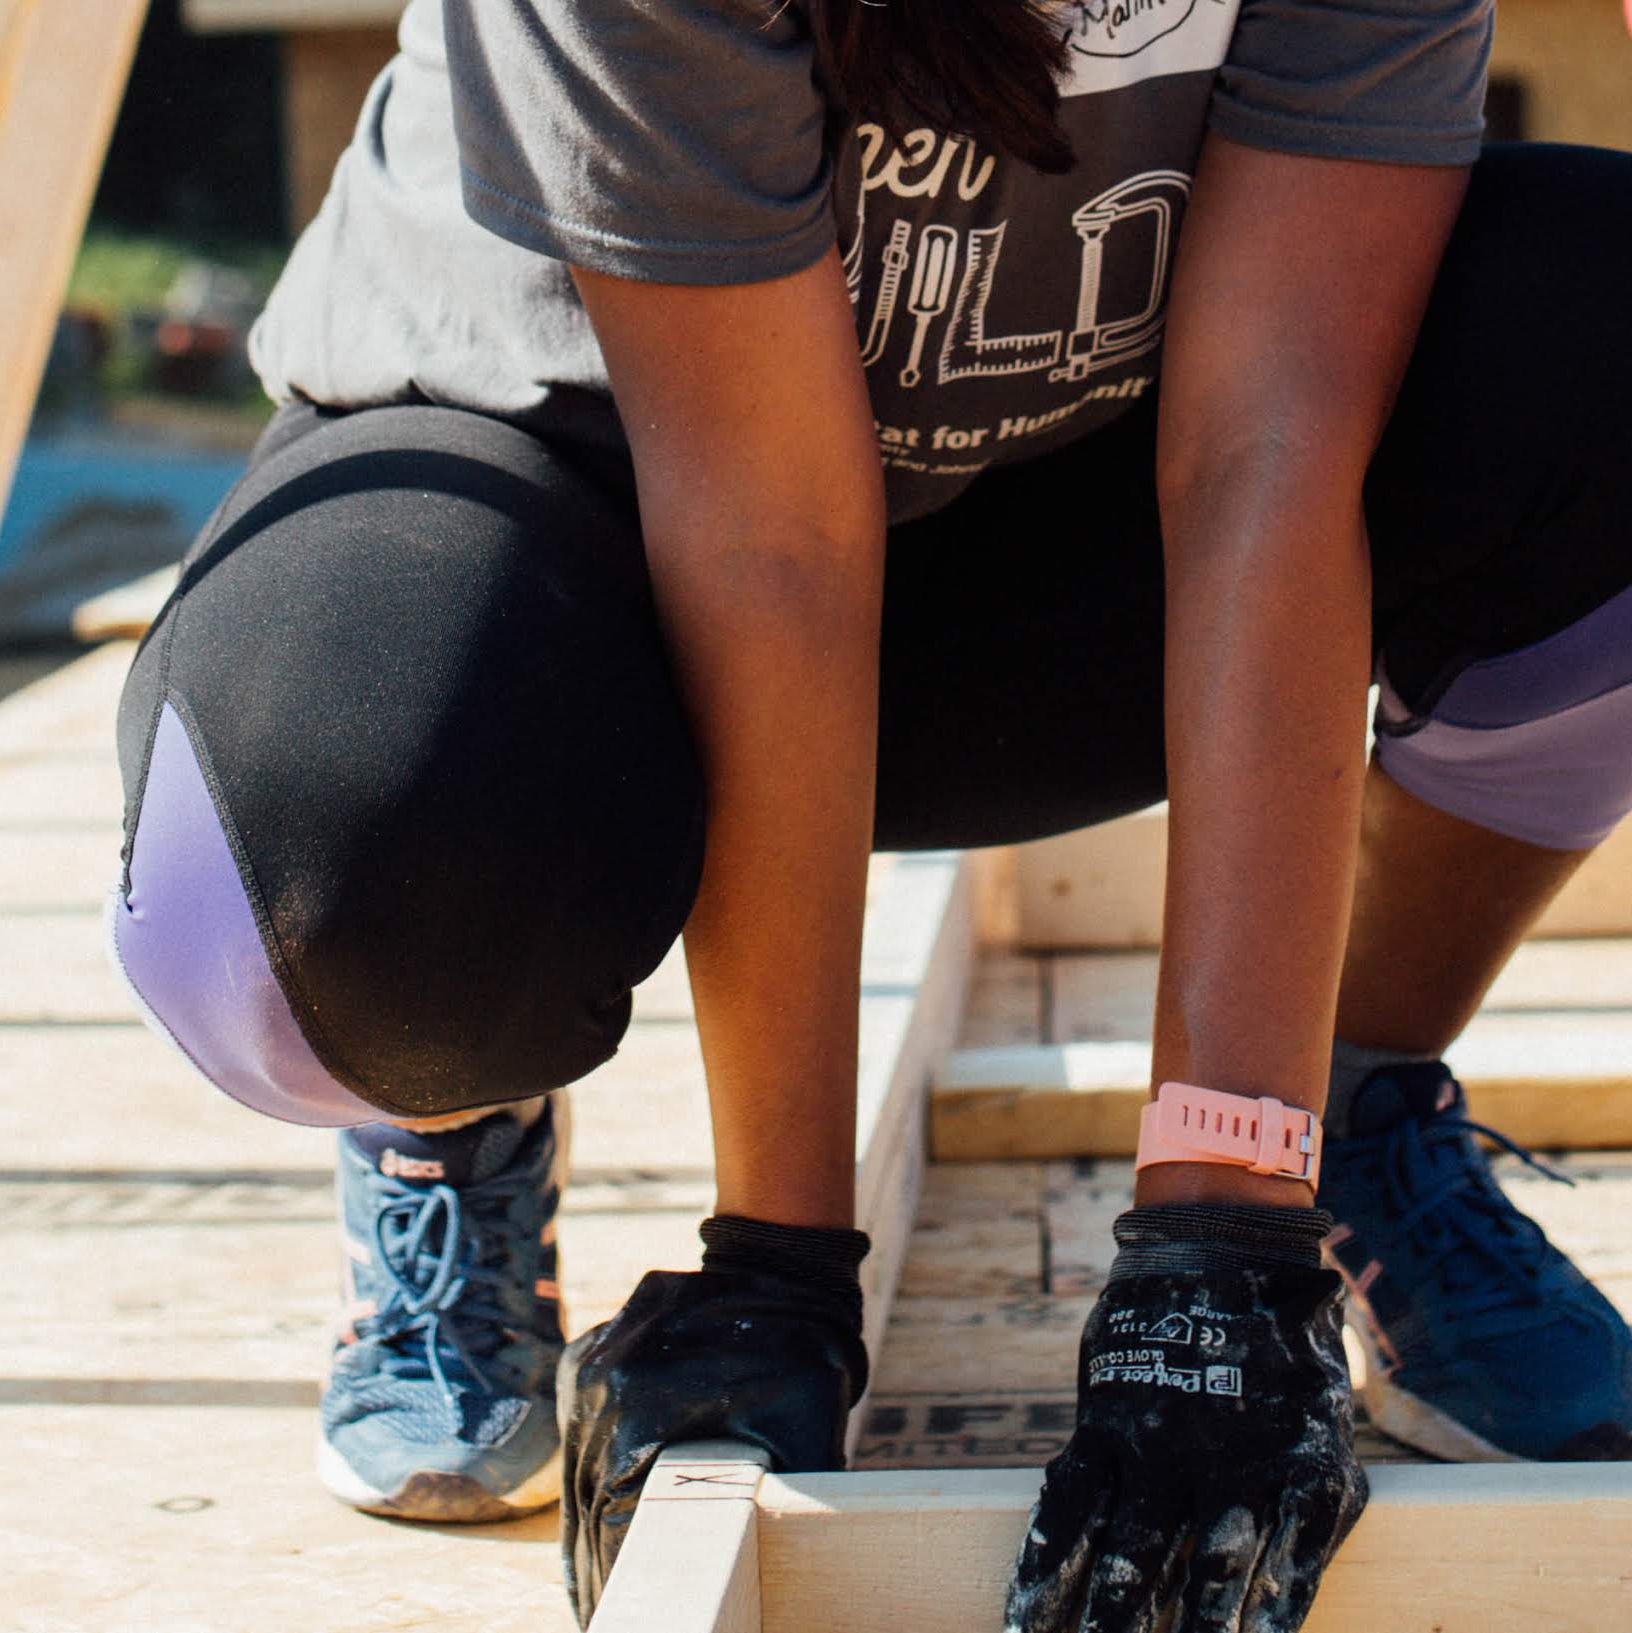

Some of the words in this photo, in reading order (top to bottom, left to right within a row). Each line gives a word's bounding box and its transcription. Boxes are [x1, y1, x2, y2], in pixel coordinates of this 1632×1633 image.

[932, 424, 989, 451] for
[1189, 1304, 1232, 1321] LARGE
[1128, 1349, 1165, 1363] GLOVE
